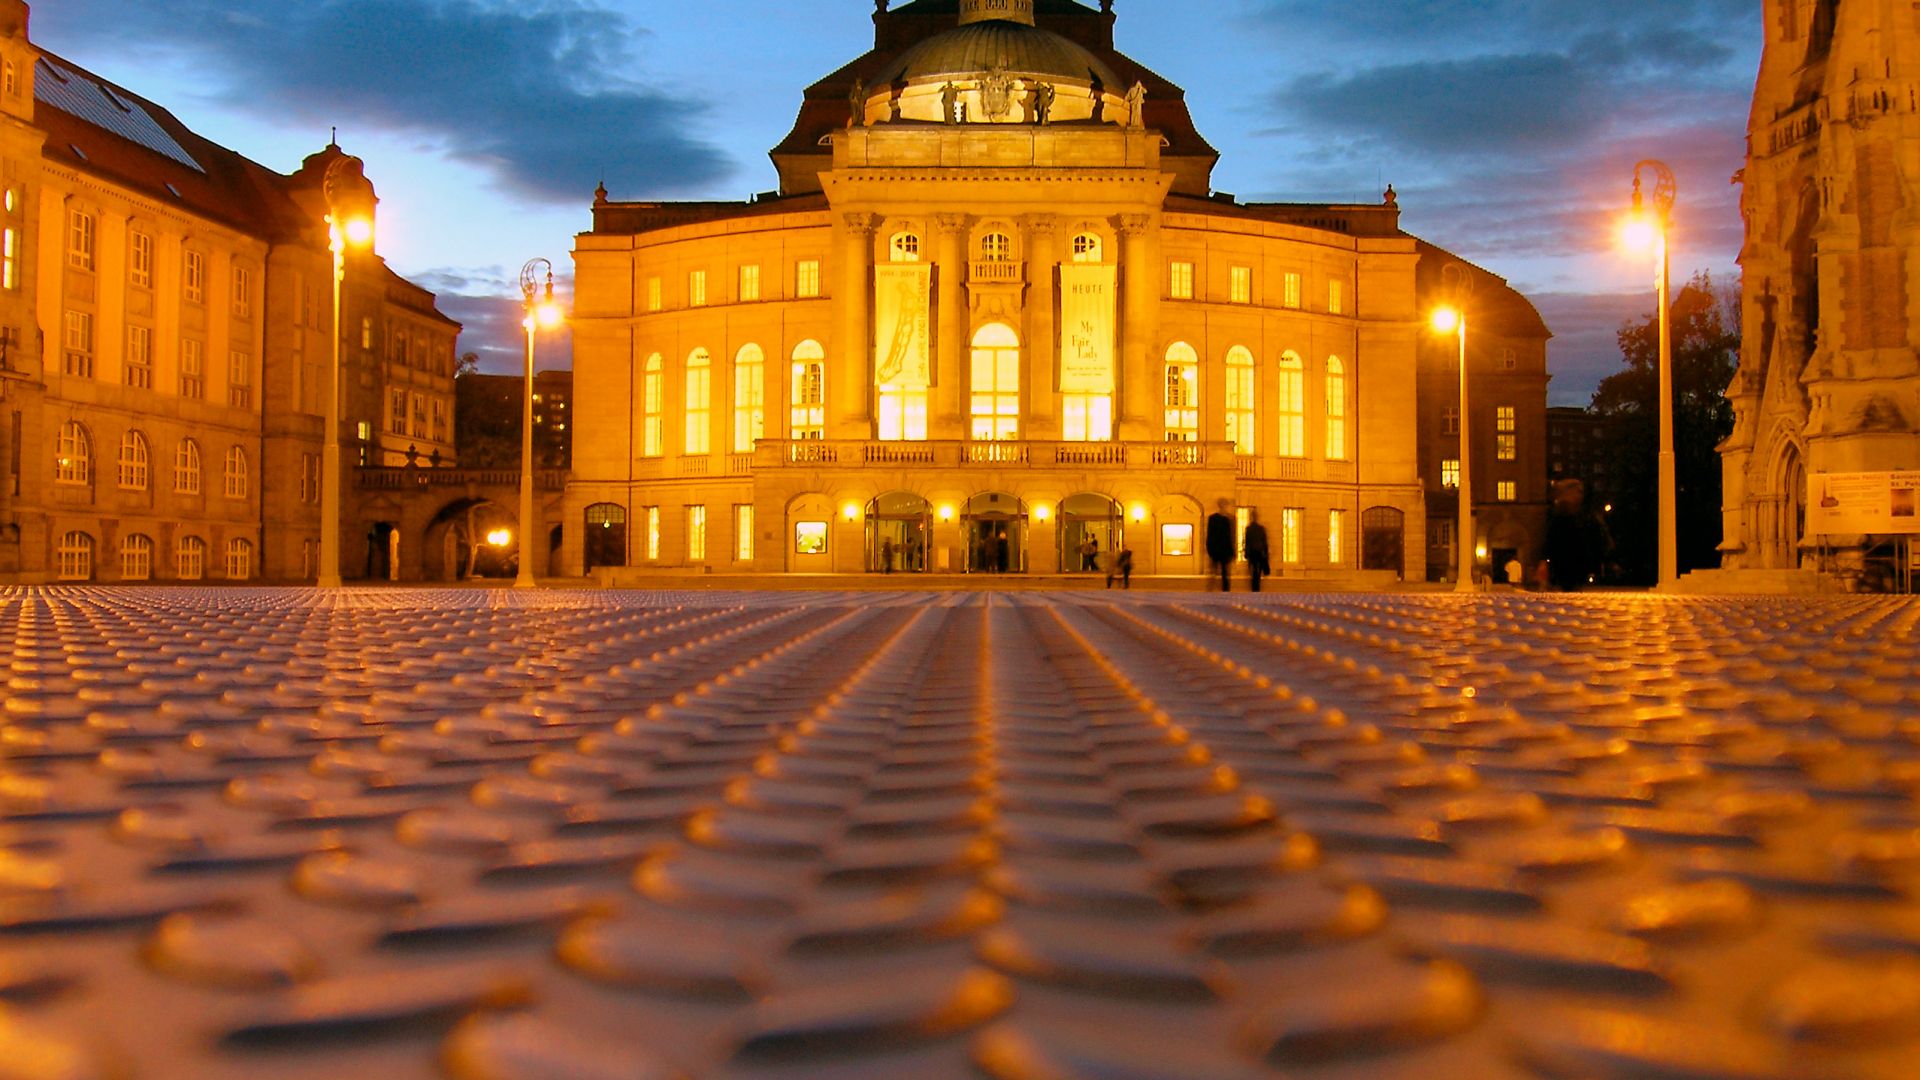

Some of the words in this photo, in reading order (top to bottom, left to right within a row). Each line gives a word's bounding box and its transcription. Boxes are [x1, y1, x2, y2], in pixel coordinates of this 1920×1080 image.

[1072, 284, 1103, 294] HEUTE
[1081, 320, 1094, 336] My
[1078, 344, 1098, 361] Lady
